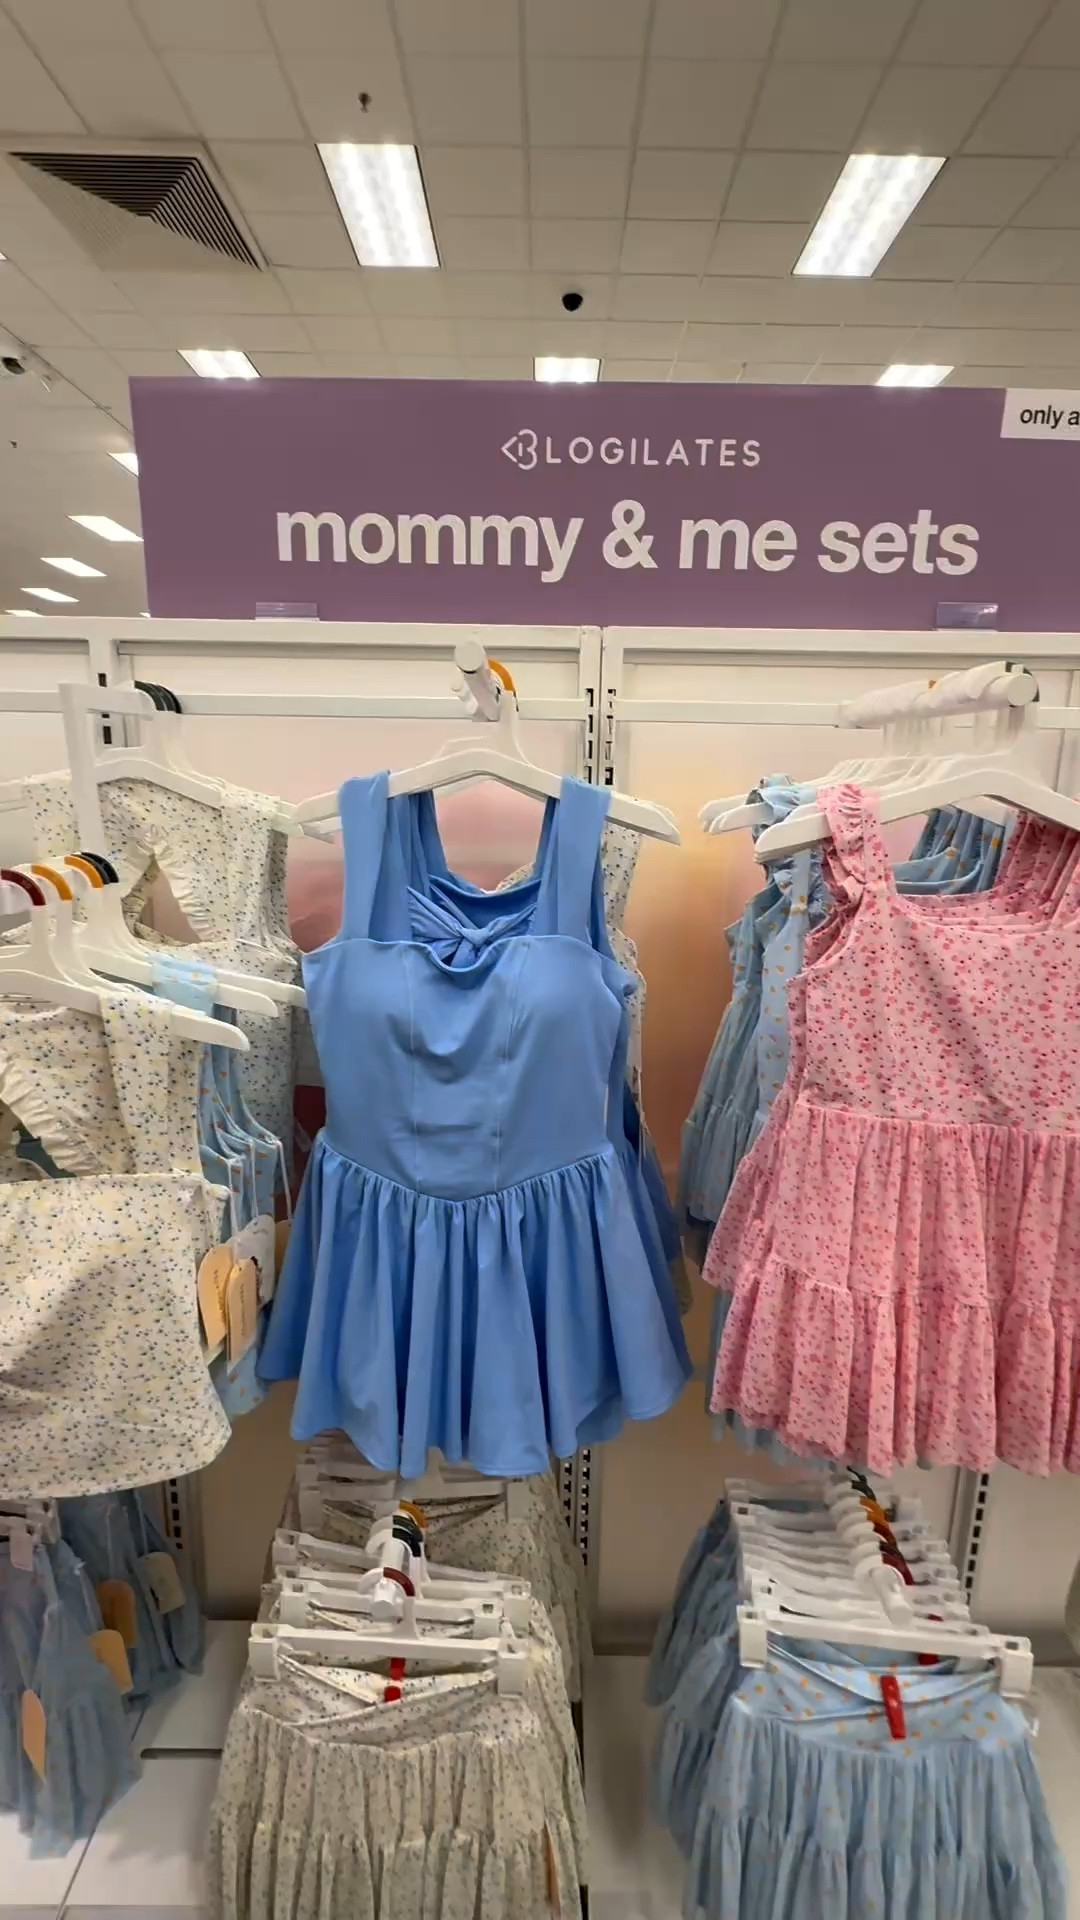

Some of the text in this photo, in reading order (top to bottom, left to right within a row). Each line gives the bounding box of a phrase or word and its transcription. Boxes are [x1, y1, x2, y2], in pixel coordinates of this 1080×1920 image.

[1019, 404, 1065, 430] only
[276, 499, 981, 583] mommy & me sets
